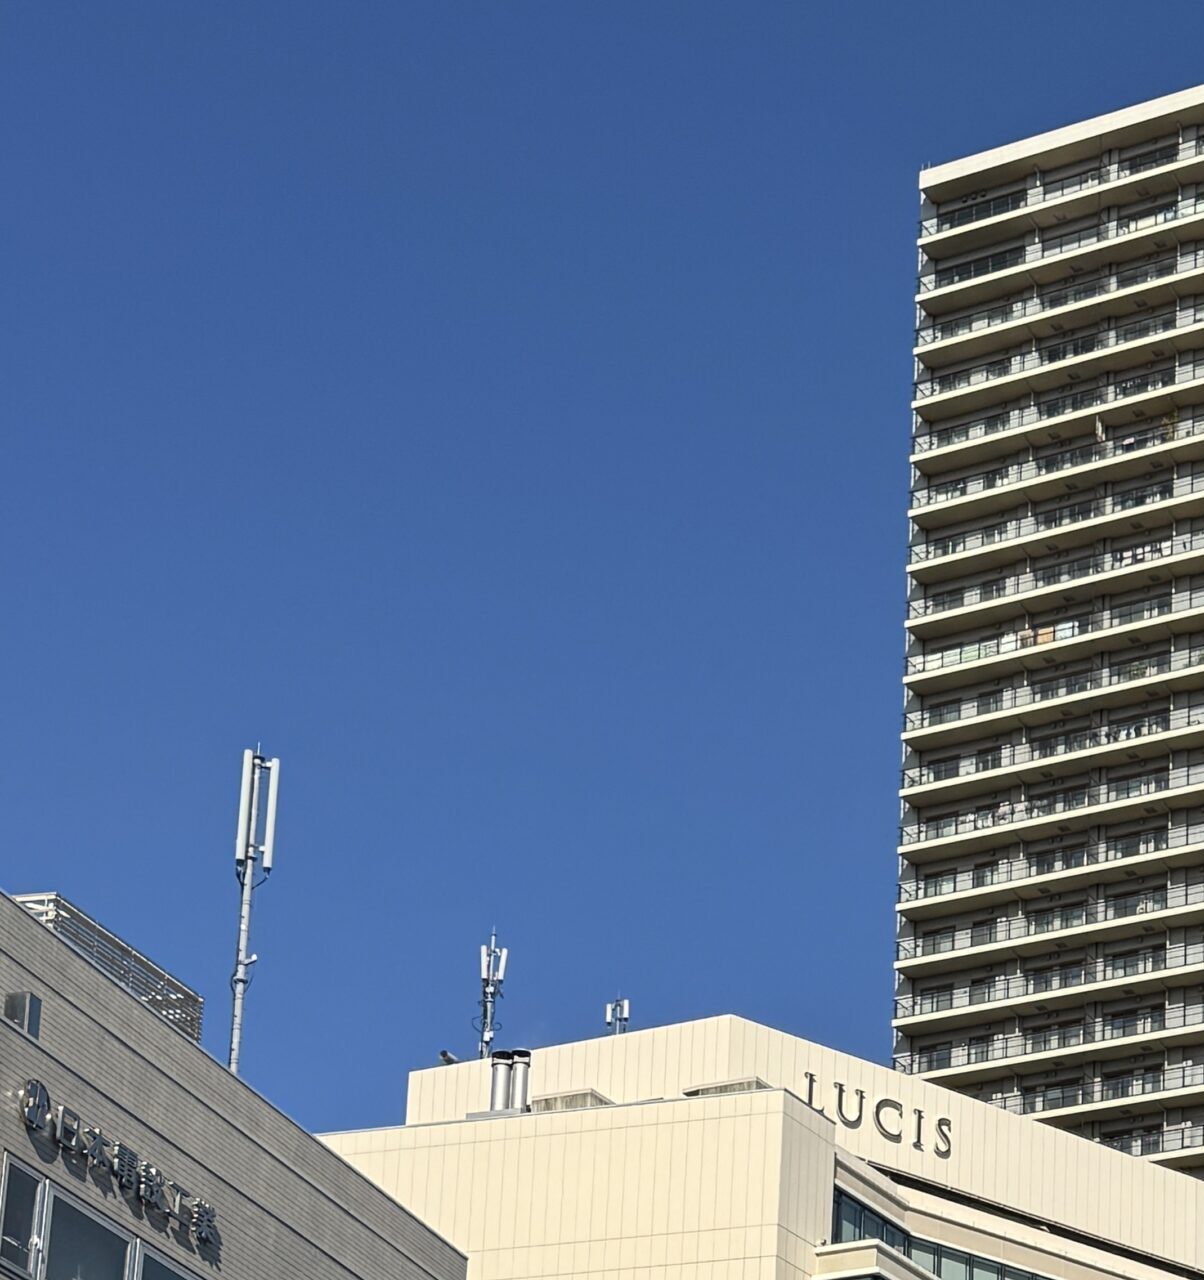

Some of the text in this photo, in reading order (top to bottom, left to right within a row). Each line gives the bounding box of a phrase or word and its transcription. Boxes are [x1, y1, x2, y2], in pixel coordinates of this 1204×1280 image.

[803, 1071, 952, 1160] LUCIS
[56, 1105, 217, 1244] 日本電設工業
